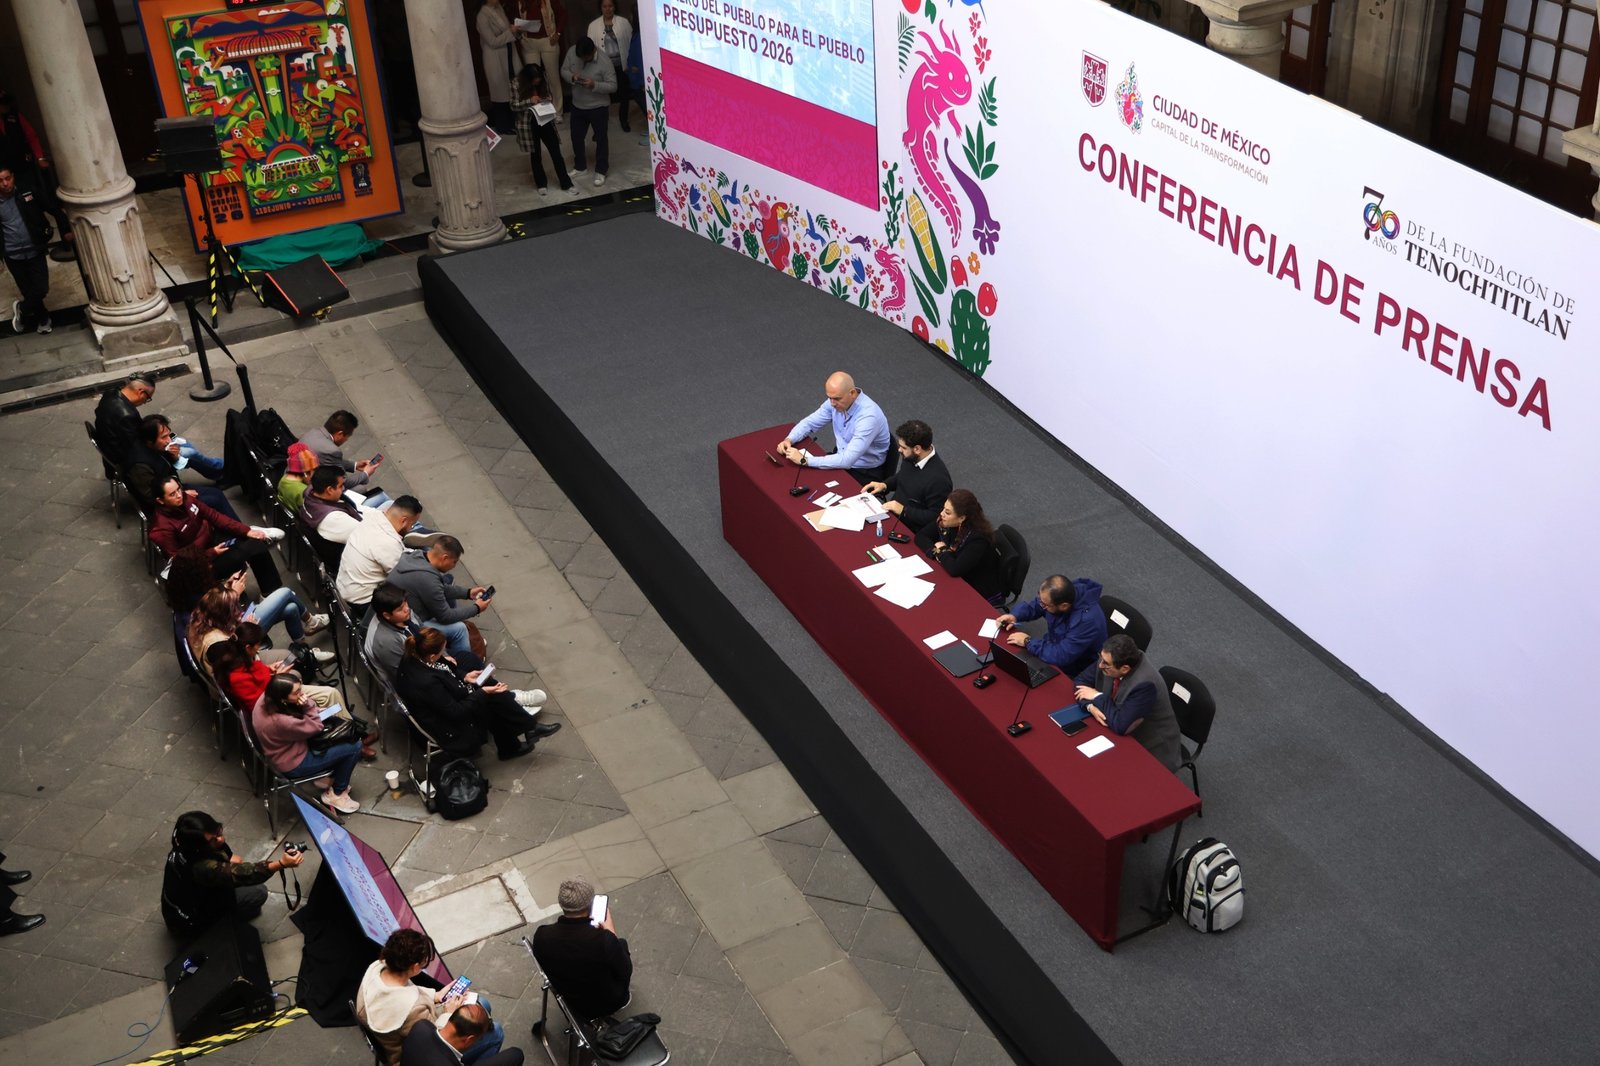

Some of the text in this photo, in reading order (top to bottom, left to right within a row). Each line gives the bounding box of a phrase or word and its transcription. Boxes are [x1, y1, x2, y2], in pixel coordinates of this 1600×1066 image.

[663, 4, 794, 66] PRESUPUESTO 2026
[723, 3, 765, 31] PUEBLO
[769, 18, 799, 43] PARA
[802, 29, 816, 48] EL
[818, 38, 865, 64] PUEBLO
[1151, 118, 1269, 185] CAPITAL DE LA TRANSFORMACIÓN
[1153, 95, 1271, 165] CIUDAD DE MÉXICO
[1372, 235, 1398, 255] AÑOS
[1407, 220, 1576, 315] DE LA FUNDACIÓN DE
[1078, 132, 1552, 432] CONFERENCIA DE PRENSA
[1404, 239, 1571, 341] TENOCHTITLAN
